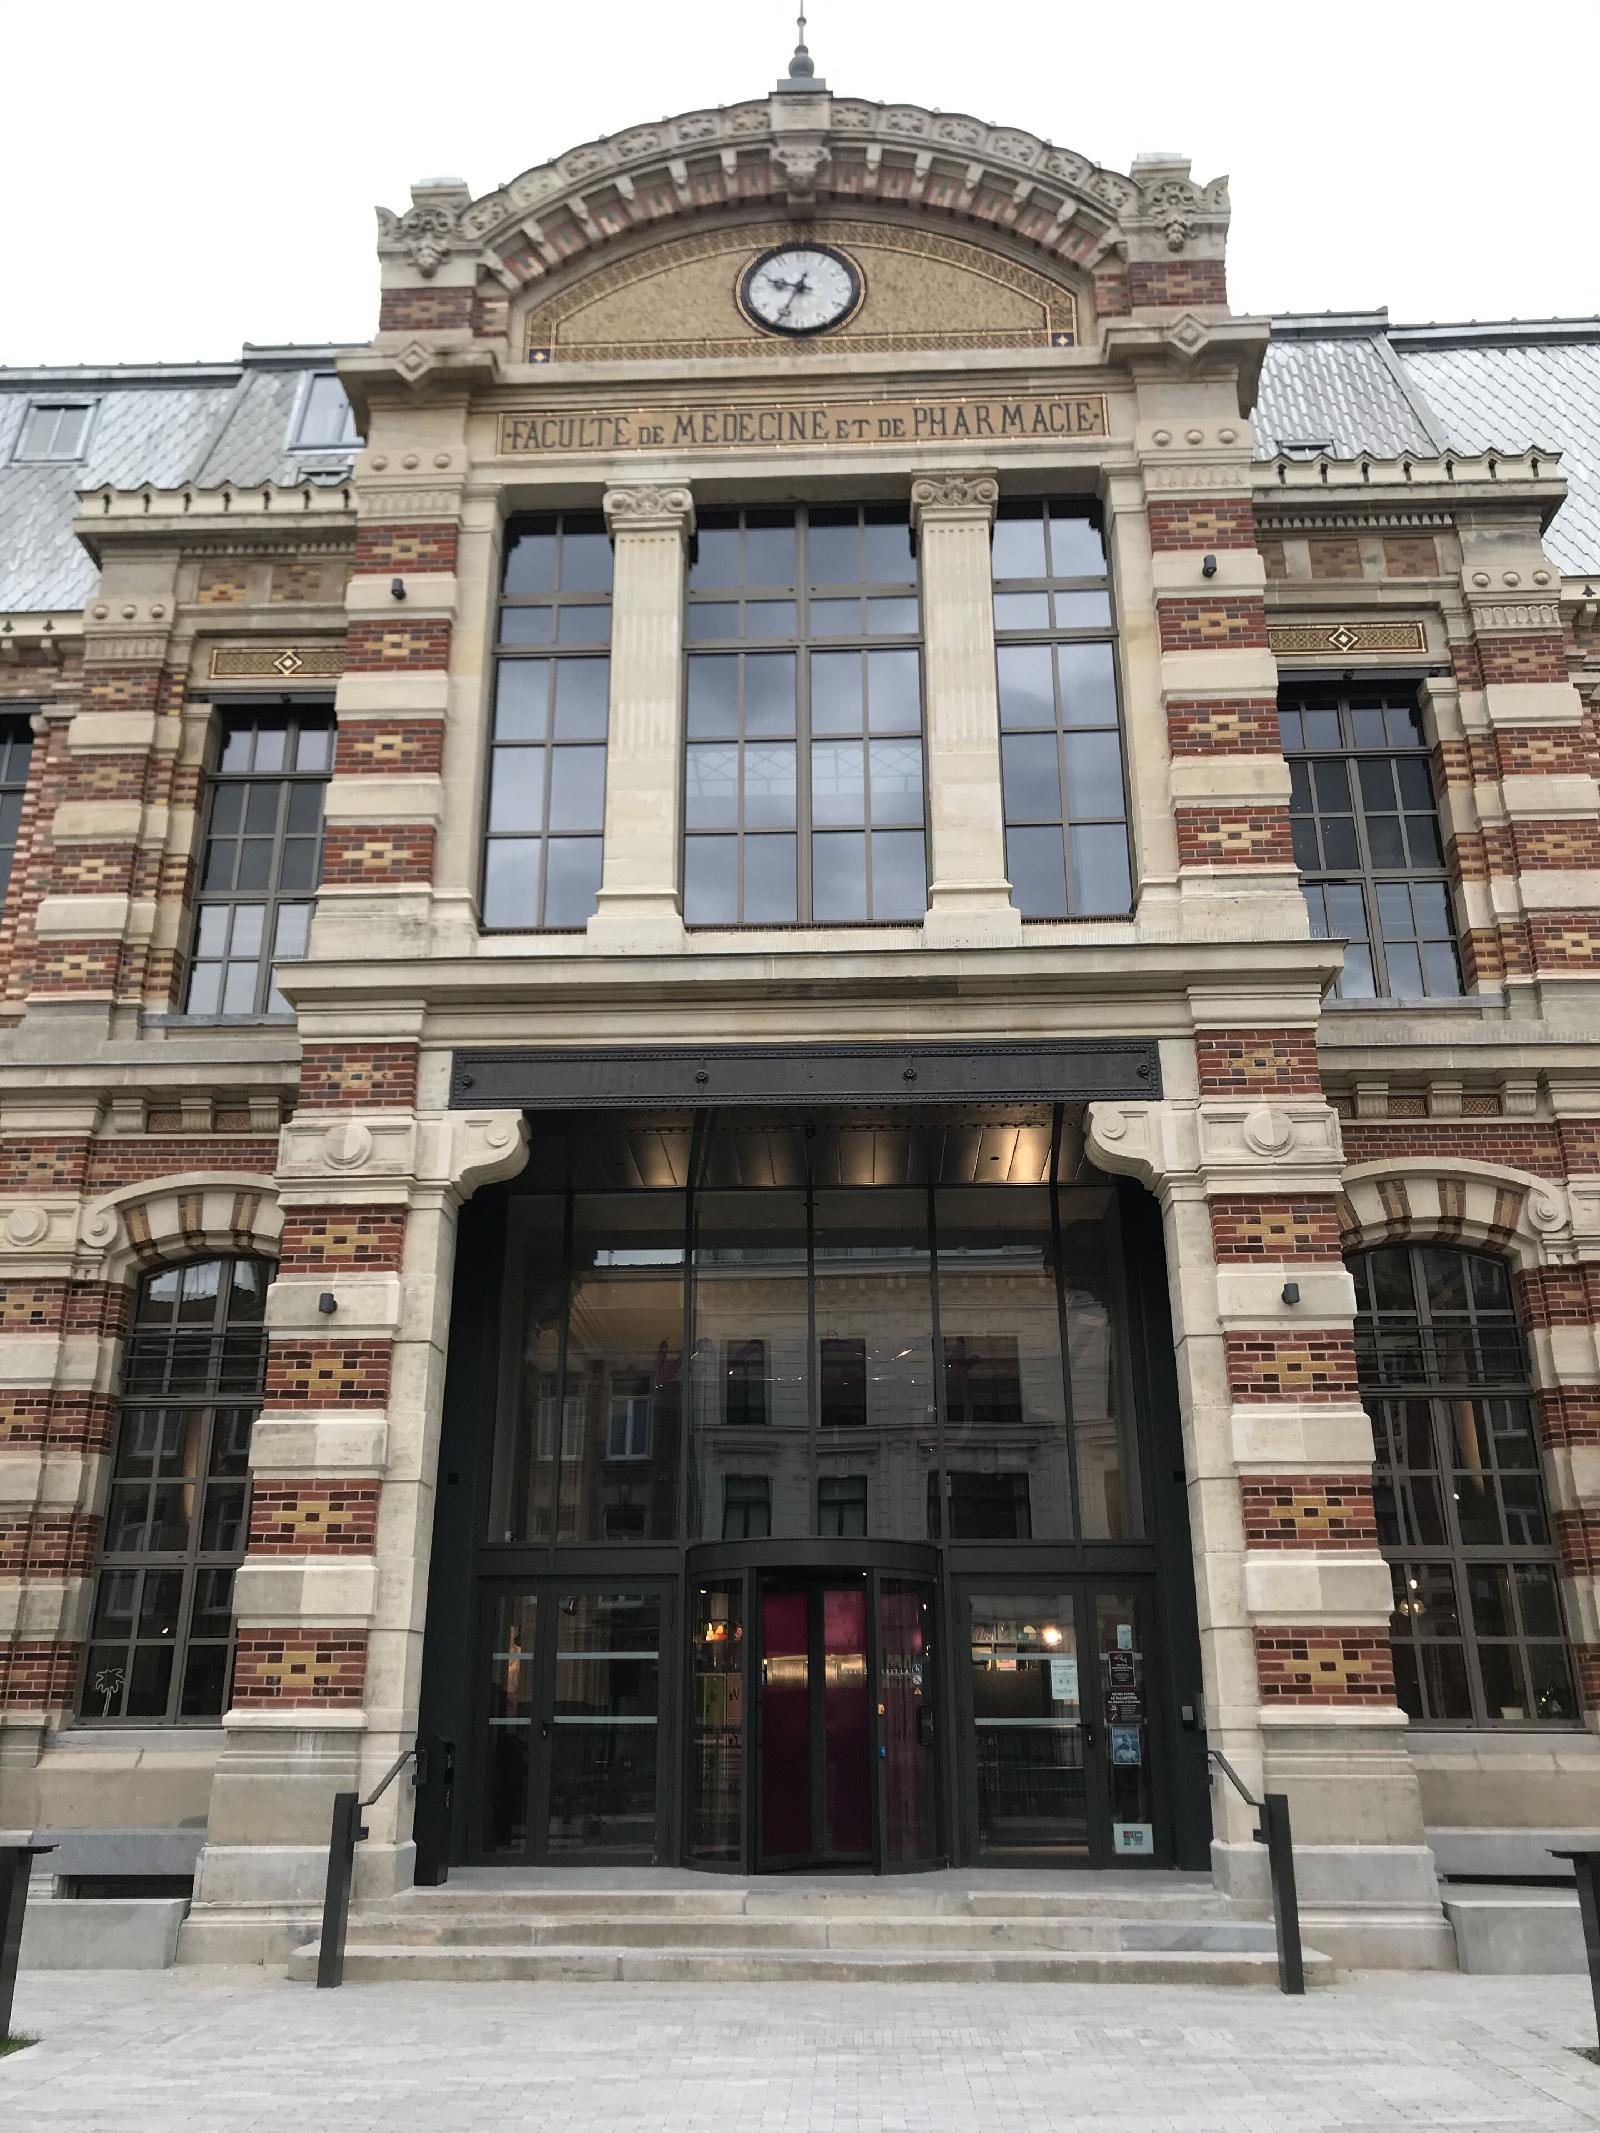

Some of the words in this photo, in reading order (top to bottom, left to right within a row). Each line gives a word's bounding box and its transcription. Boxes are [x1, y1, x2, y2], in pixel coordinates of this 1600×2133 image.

[510, 416, 632, 450] FACULTE
[637, 425, 665, 445] DE
[671, 409, 830, 445] MEDECINE
[835, 417, 870, 439] ET
[877, 417, 905, 438] DE
[912, 402, 1096, 436] PHARMACIE
